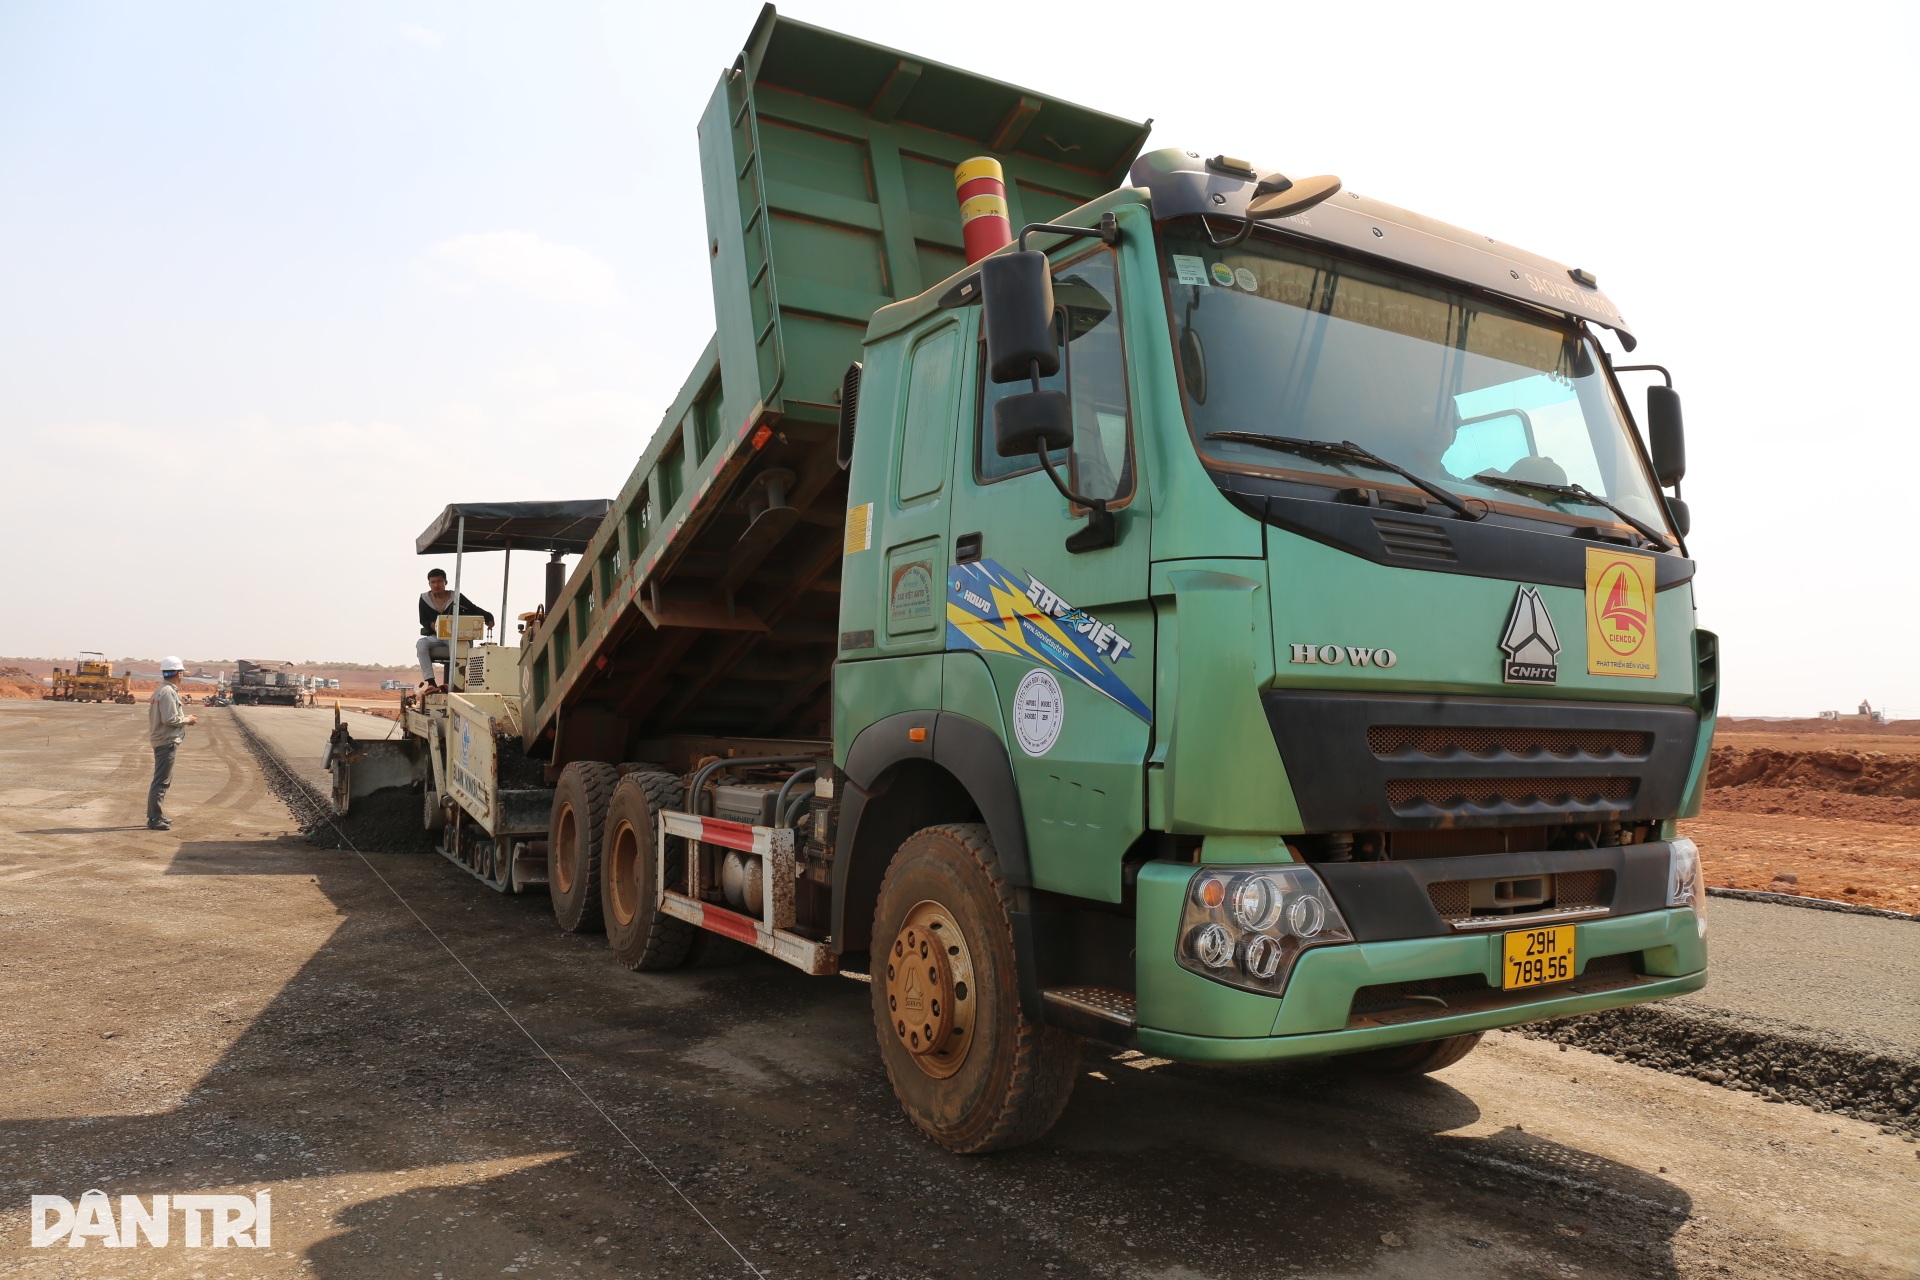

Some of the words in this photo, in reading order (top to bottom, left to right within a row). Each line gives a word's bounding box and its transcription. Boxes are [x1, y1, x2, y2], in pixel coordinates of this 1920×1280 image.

[1524, 272, 1581, 306] SAOVIET
[1579, 291, 1614, 318] AUTO
[963, 589, 992, 614] HOWO
[1609, 633, 1637, 644] CIENCO4
[1289, 643, 1397, 668] HOWO
[1509, 665, 1556, 679] CNHTC
[1526, 930, 1556, 956] 29H
[1513, 955, 1568, 985] 789.56
